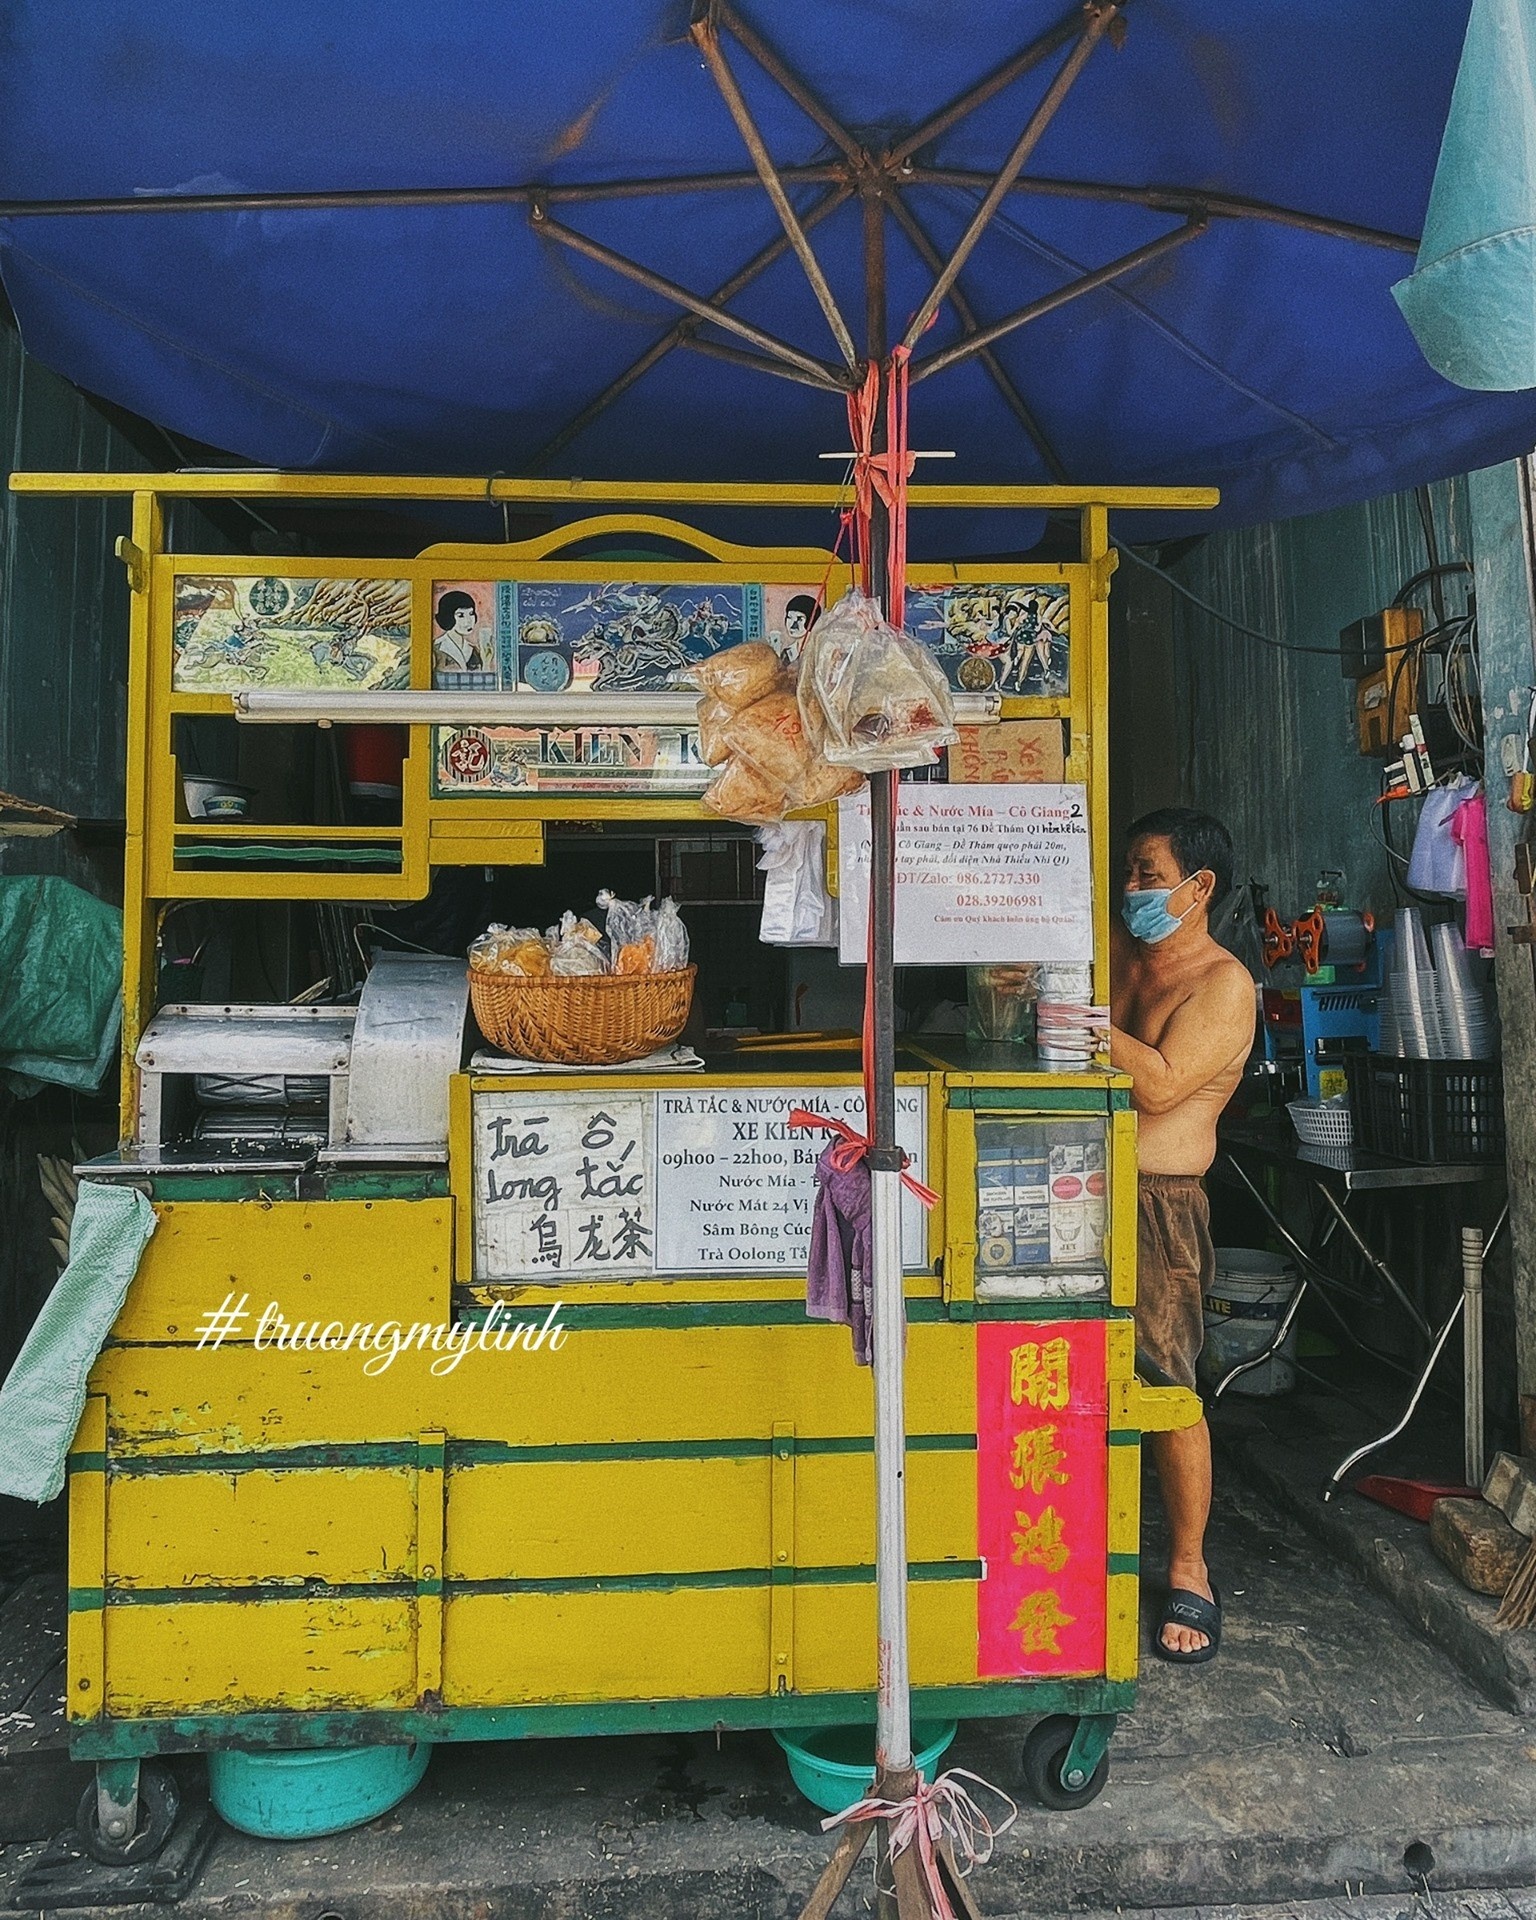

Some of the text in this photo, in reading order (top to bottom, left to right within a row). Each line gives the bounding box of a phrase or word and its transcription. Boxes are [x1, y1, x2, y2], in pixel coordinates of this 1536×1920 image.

[912, 805, 924, 816] &
[929, 804, 965, 817] Nước
[968, 805, 994, 817] Mía
[1009, 805, 1027, 818] Cô
[1031, 805, 1070, 820] Giang
[1070, 803, 1083, 818] 2
[913, 825, 930, 833] sau
[932, 823, 950, 833] bán
[967, 824, 979, 833] 76
[914, 840, 942, 852] Giang
[956, 872, 1041, 885] 086.2727.330
[956, 894, 1044, 907] 028.39206981
[663, 1095, 694, 1114] TRÀ
[697, 1094, 728, 1114] TẮC
[731, 1098, 742, 1113] &
[746, 1096, 797, 1114] NƯỚC
[801, 1096, 831, 1113] MÍA
[843, 1095, 865, 1113] CÔ
[732, 1121, 759, 1141] XE
[663, 1148, 715, 1170] 09h00
[732, 1148, 788, 1167] 22h00,
[719, 1174, 764, 1188] Nước
[767, 1174, 796, 1188] Mía
[690, 1198, 809, 1214] Nước Mát 24 Vị
[702, 1222, 811, 1239] Sâm Bông Cúc
[697, 1245, 808, 1263] Trà Oolong Tắ
